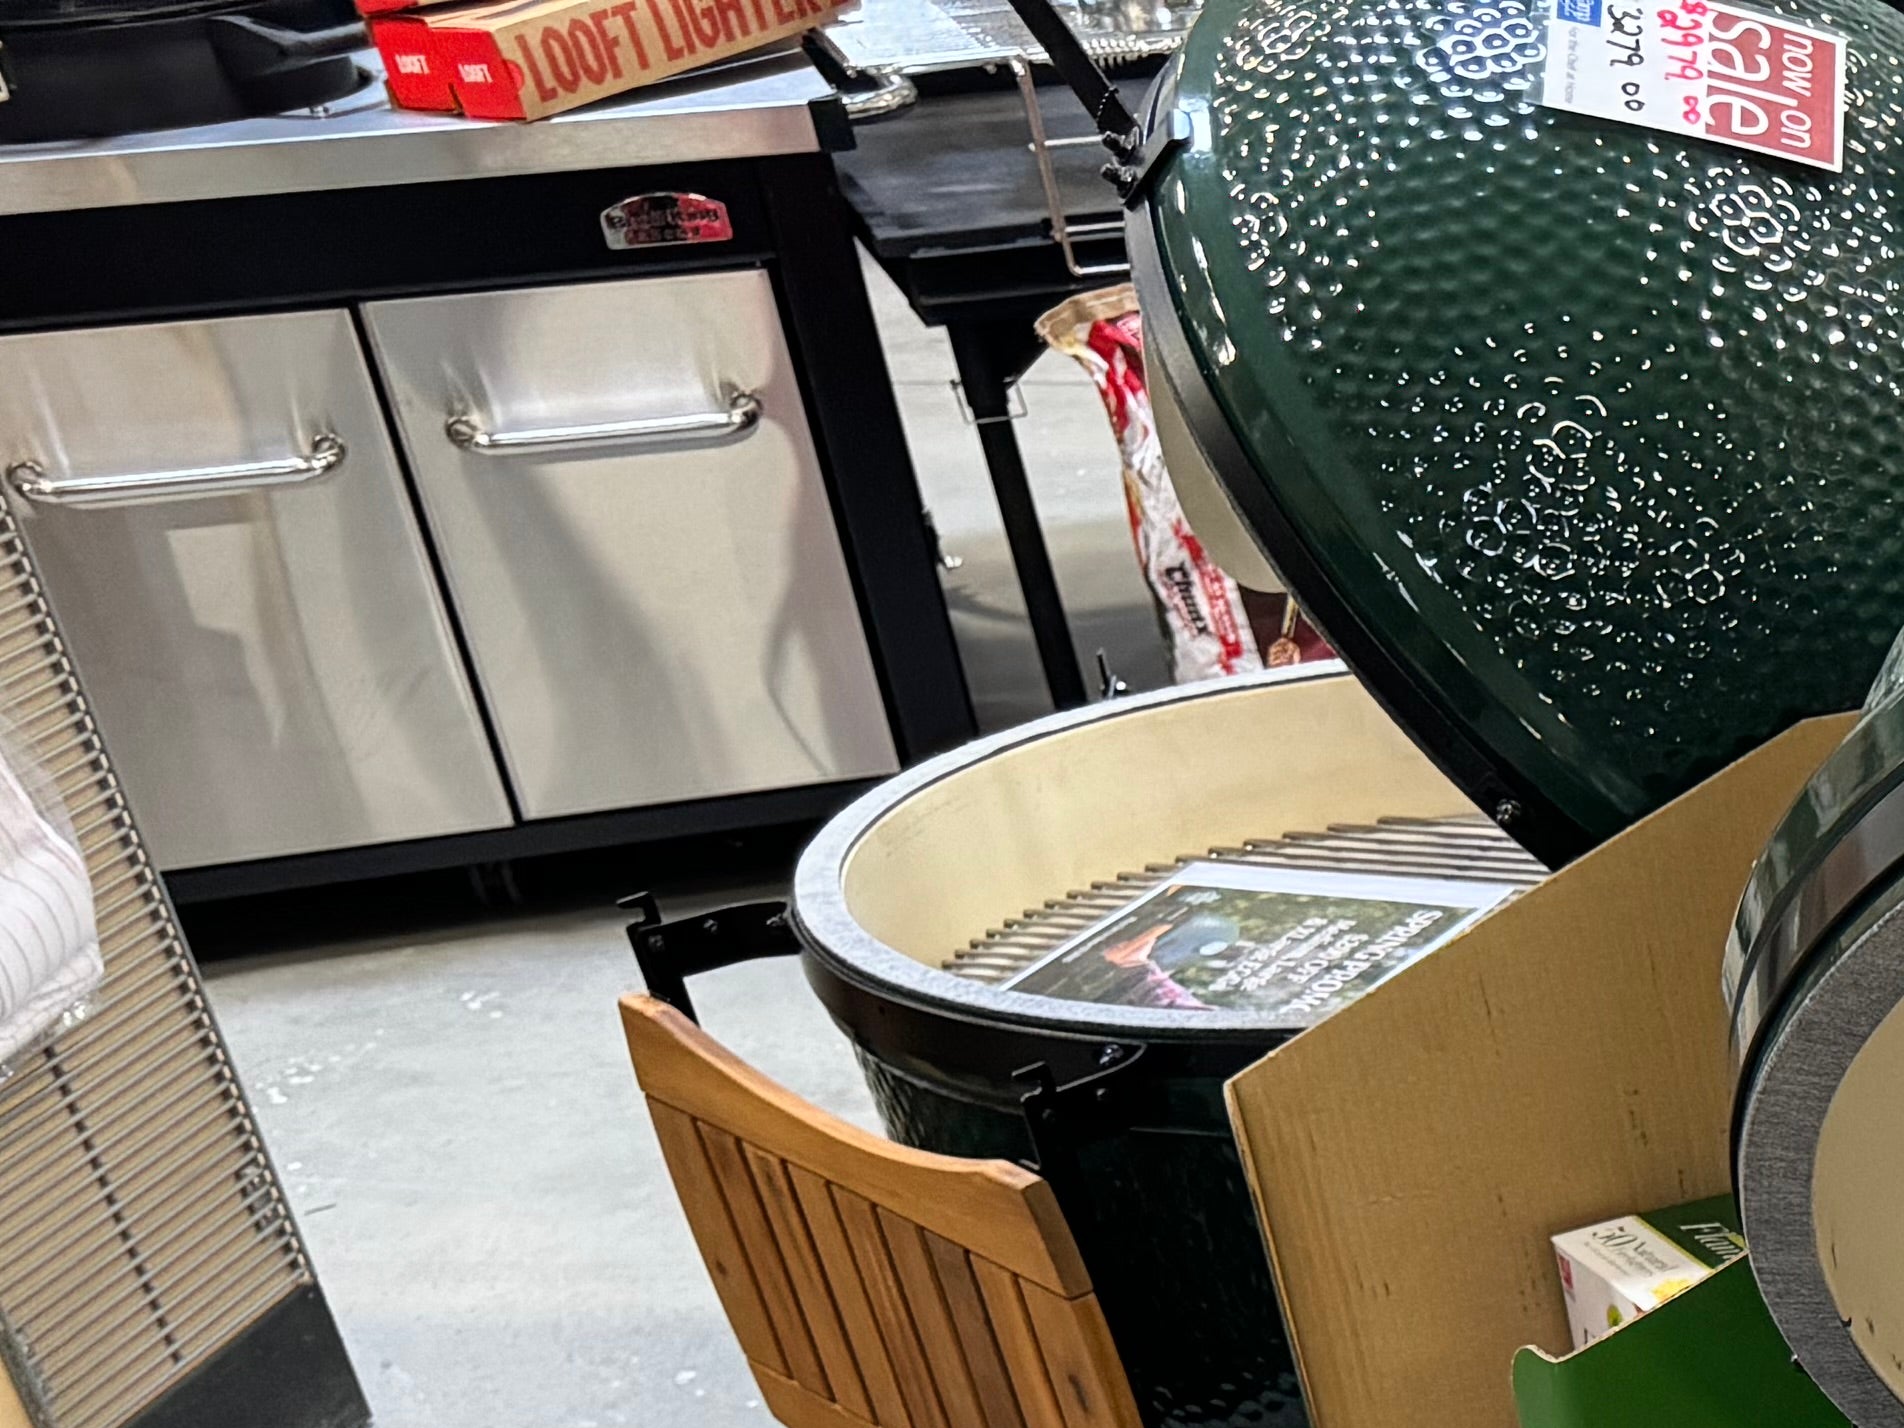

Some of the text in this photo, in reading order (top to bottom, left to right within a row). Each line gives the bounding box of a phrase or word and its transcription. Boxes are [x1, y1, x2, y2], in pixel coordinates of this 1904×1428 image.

[458, 64, 492, 84] LOOFT
[517, 2, 651, 102] LOOFT
[1707, 13, 1798, 136] sale
[1780, 33, 1814, 149] now on
